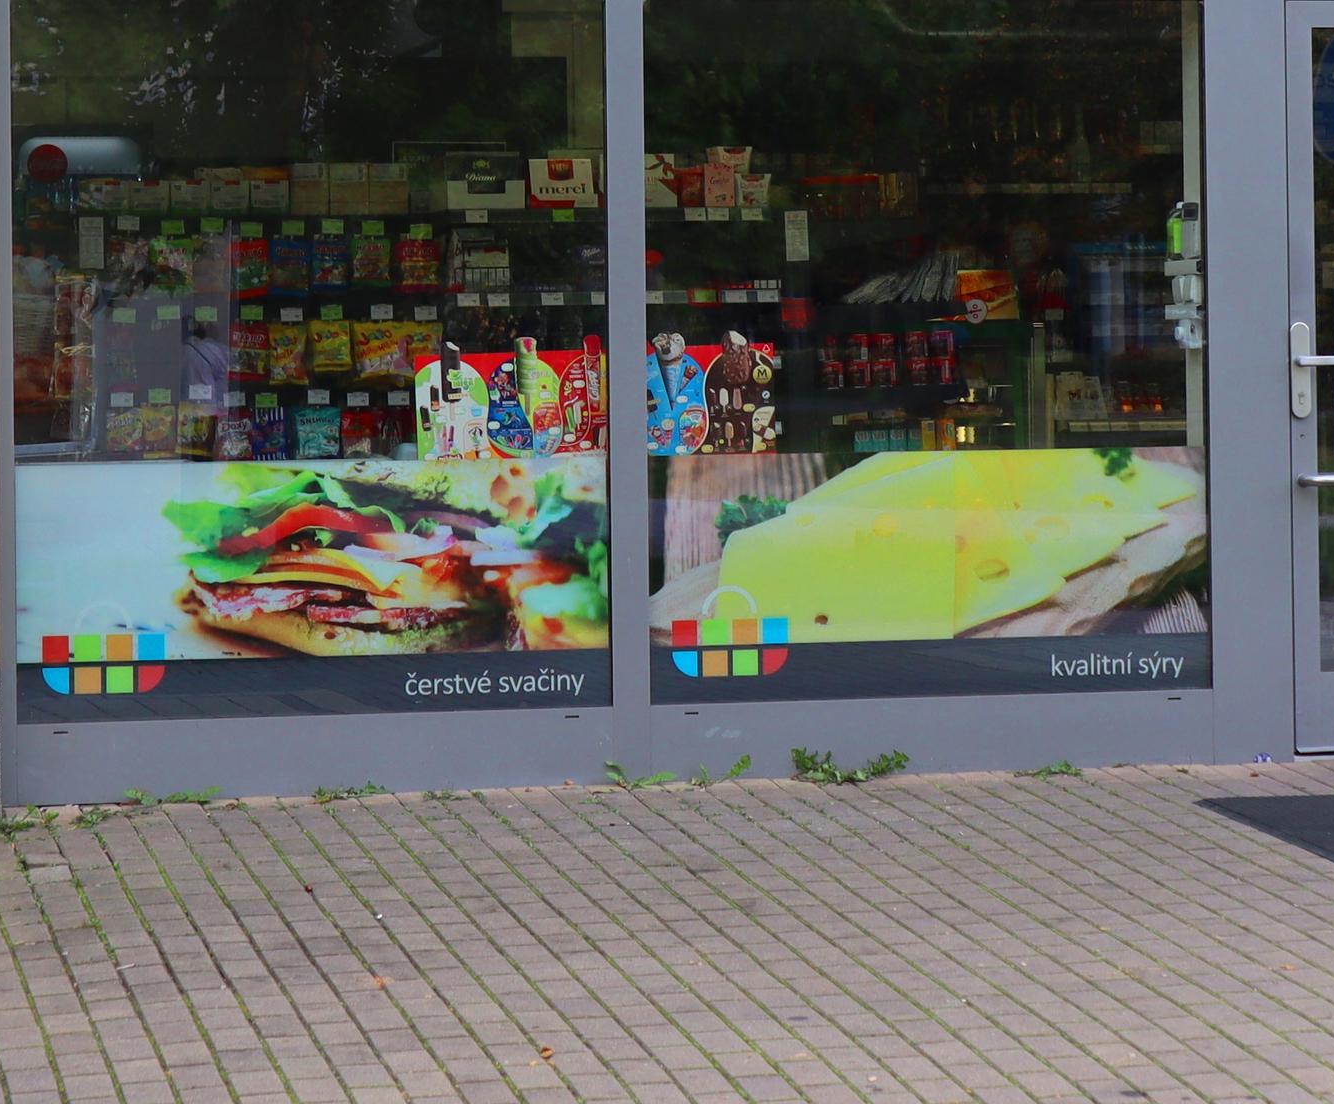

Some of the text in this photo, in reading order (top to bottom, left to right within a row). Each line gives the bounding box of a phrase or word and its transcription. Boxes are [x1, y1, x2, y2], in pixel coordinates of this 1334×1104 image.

[538, 183, 587, 194] merci
[221, 418, 248, 433] Doxy
[1050, 650, 1184, 680] kvalitní sýry
[404, 667, 585, 699] čerstvé svačiny
